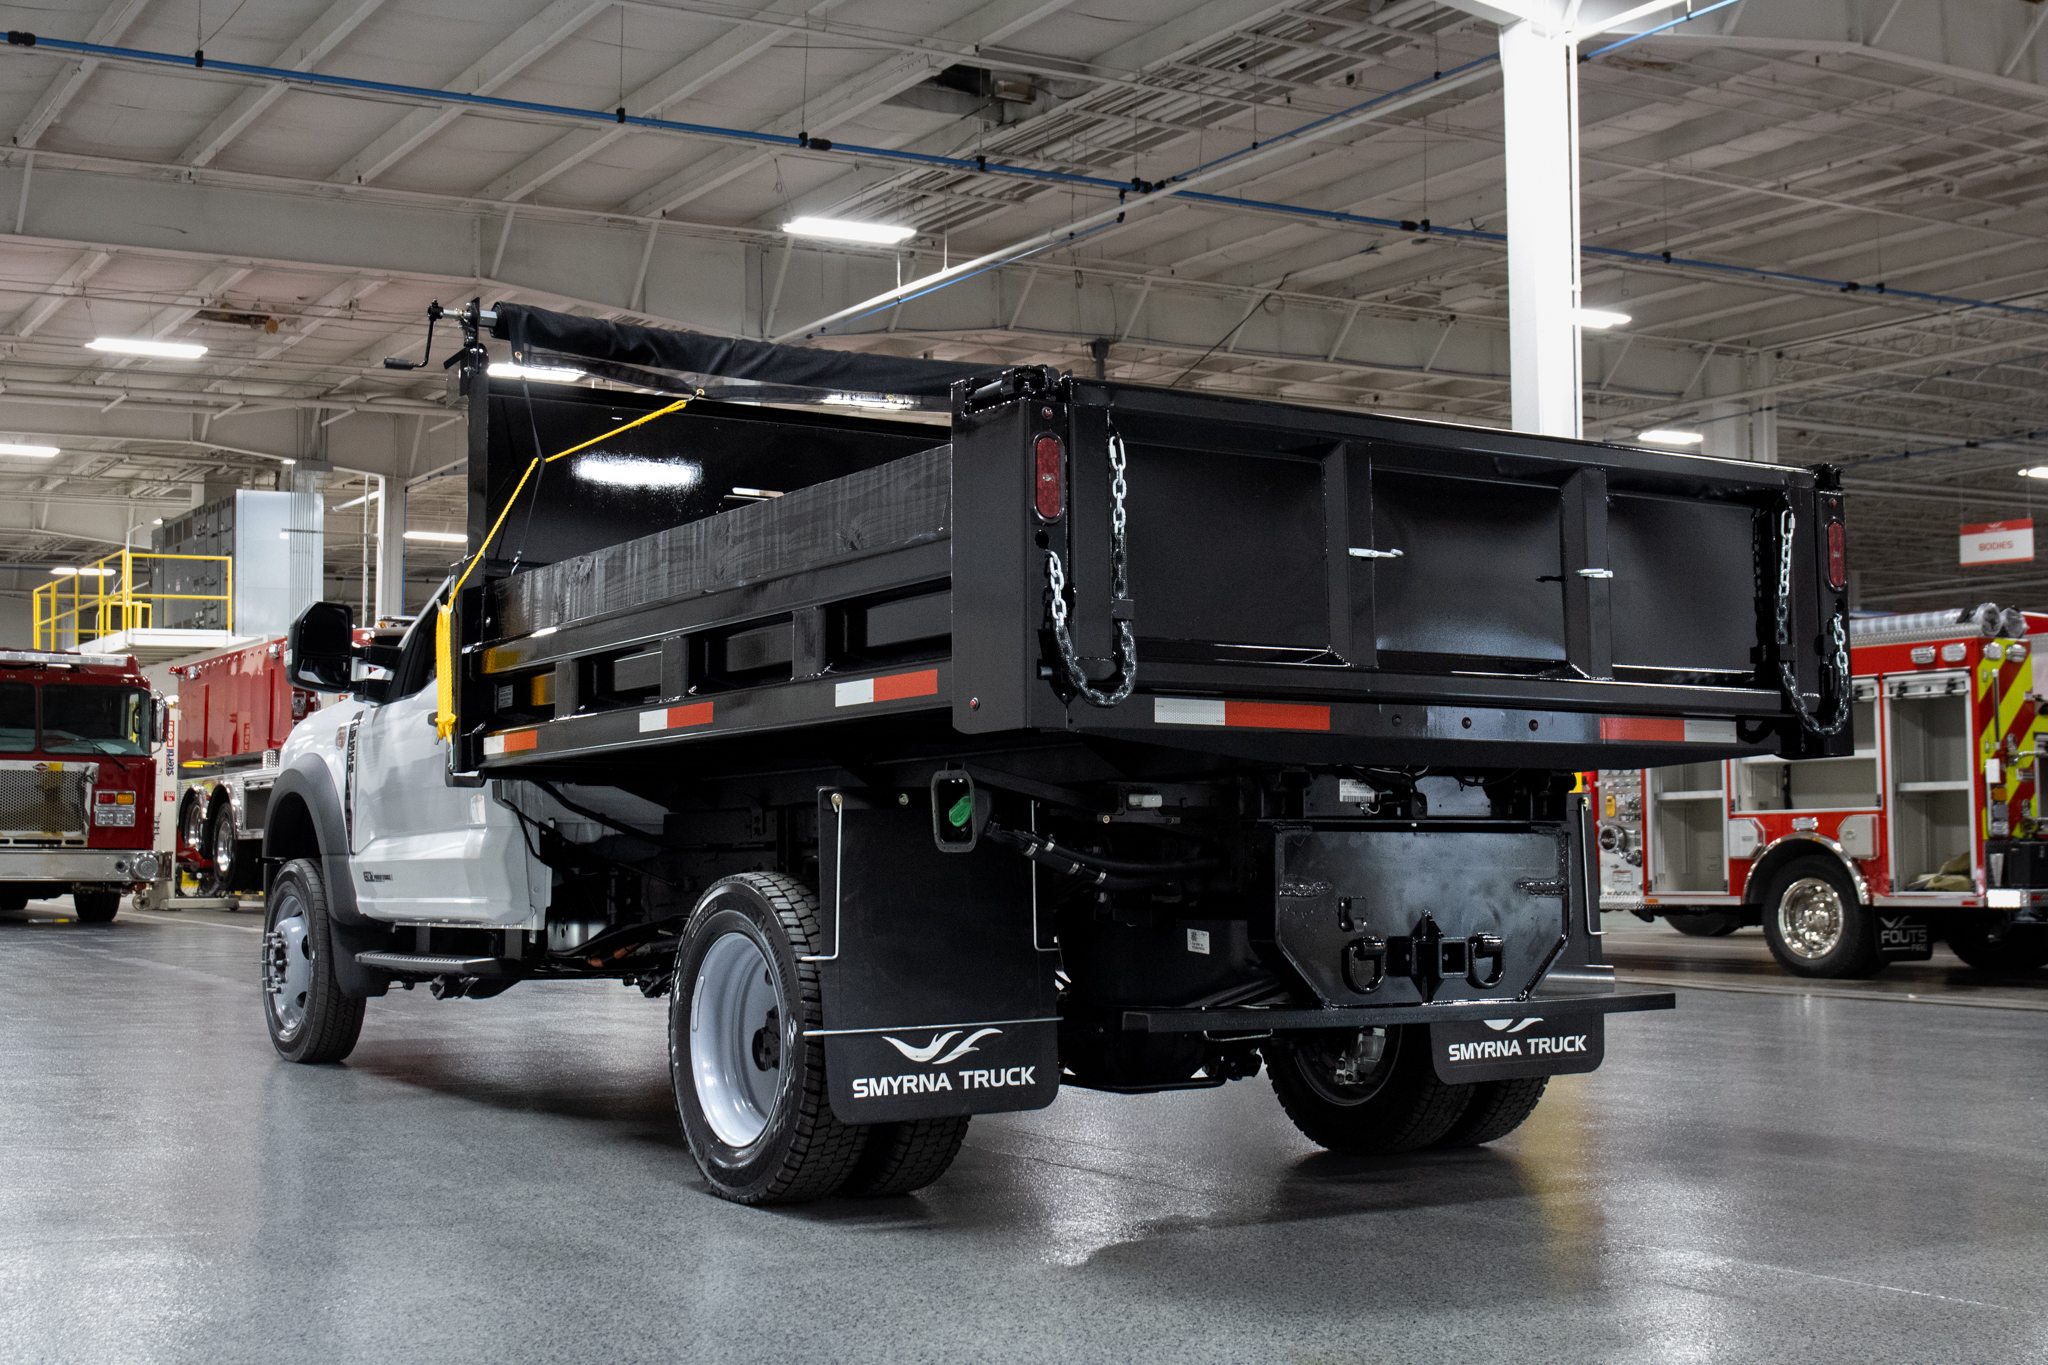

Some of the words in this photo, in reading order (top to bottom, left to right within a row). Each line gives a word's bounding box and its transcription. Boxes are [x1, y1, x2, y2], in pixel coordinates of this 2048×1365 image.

[1978, 540, 2014, 552] BODIES
[1881, 930, 1927, 944] FOUTS
[1448, 1039, 1522, 1062] SMYRNA
[1527, 1034, 1587, 1055] TRUCK
[852, 1072, 952, 1099] SMYRNA
[958, 1065, 1036, 1090] TRUCK
